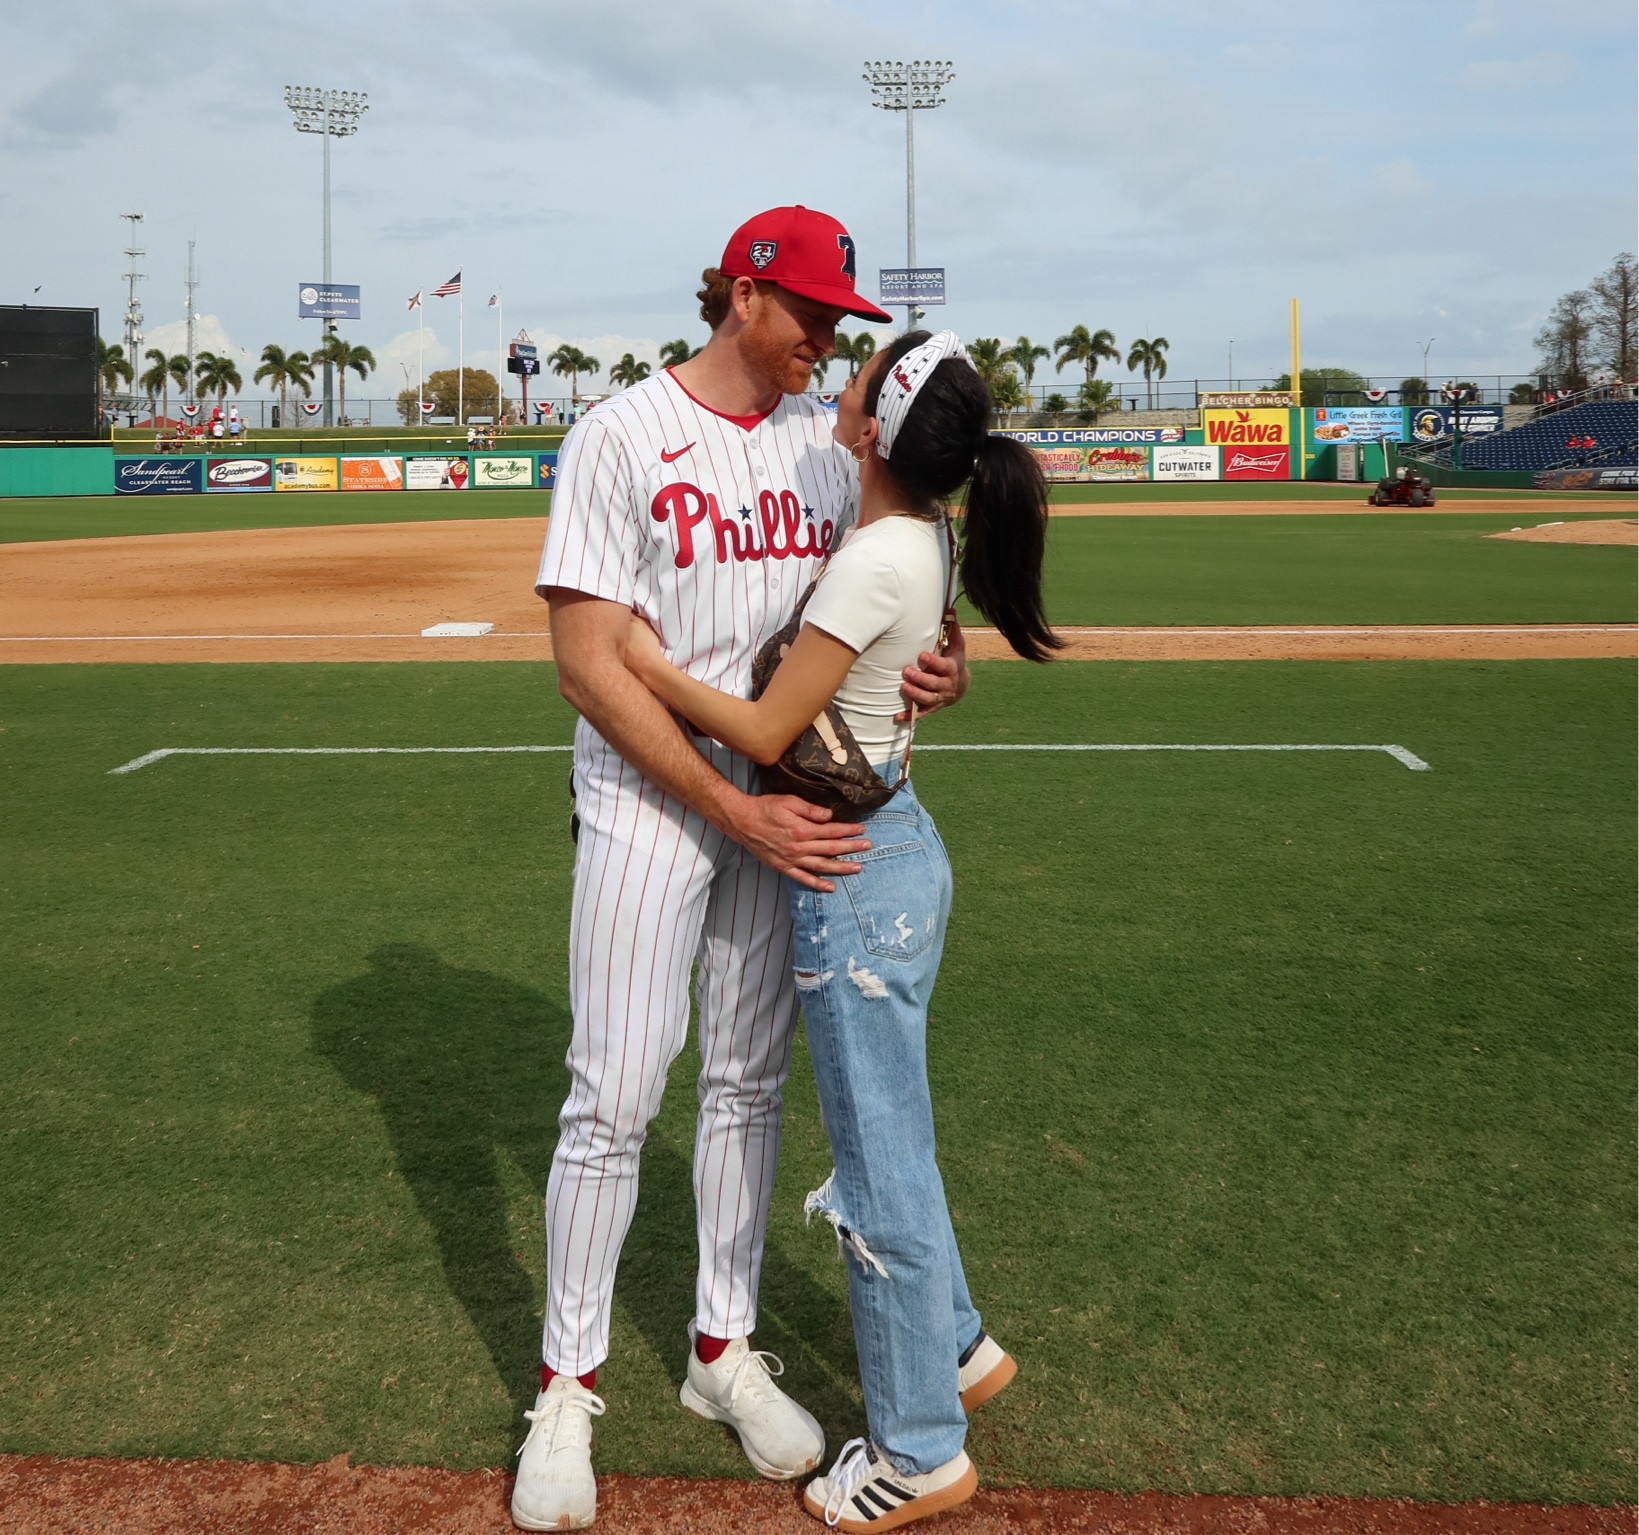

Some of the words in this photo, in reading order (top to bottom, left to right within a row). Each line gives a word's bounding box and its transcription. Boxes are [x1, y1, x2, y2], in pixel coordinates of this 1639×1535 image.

[910, 272, 943, 280] HARBOR
[1201, 396, 1250, 405] BELCHER
[1255, 396, 1290, 405] BINGO
[1329, 411, 1348, 419] Little
[1349, 410, 1368, 419] Greek
[1370, 410, 1388, 419] Fresh
[1390, 410, 1402, 419] Grill
[1001, 431, 1059, 443] WORLD
[1063, 430, 1156, 442] CHAMPIONS
[1208, 419, 1282, 443] Wawa
[1088, 448, 1139, 466] Crabby's
[1233, 456, 1279, 467] Budweiser
[120, 460, 195, 479] Sandpearl
[1087, 464, 1145, 472] HIDEAWAY
[1158, 462, 1212, 471] CUTWATER
[651, 481, 834, 569] Phillie
